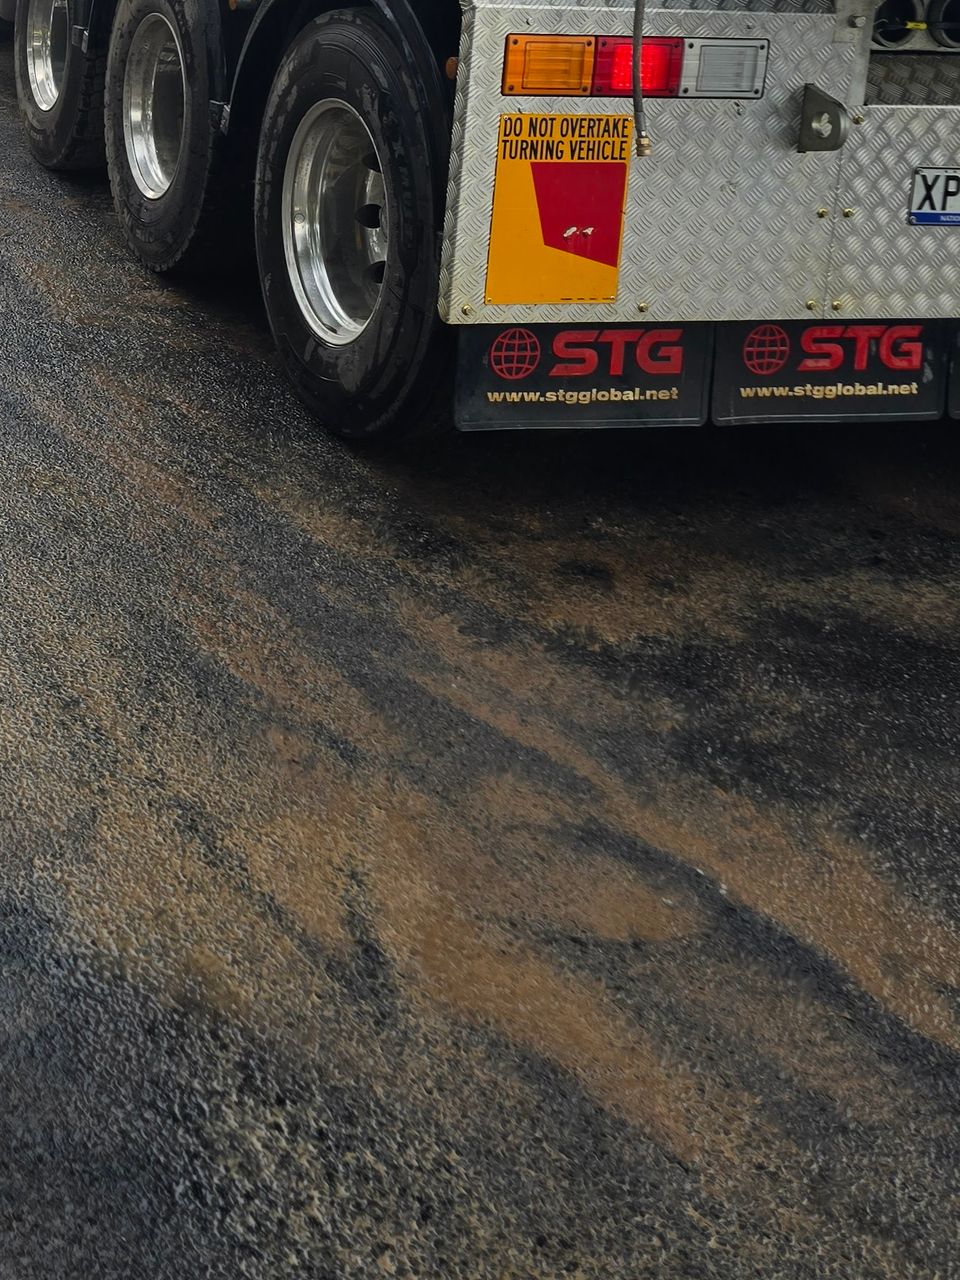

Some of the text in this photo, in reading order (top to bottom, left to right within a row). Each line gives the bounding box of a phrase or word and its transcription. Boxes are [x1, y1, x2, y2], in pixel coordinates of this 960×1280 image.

[503, 117, 629, 139] DO NOT OVERTAKE
[501, 139, 628, 160] TURNING VEHICLE
[549, 328, 684, 377] STG
[797, 325, 923, 371] STG
[486, 387, 679, 405] www.stgglobal.net
[740, 381, 919, 399] www.stgglobal.net
